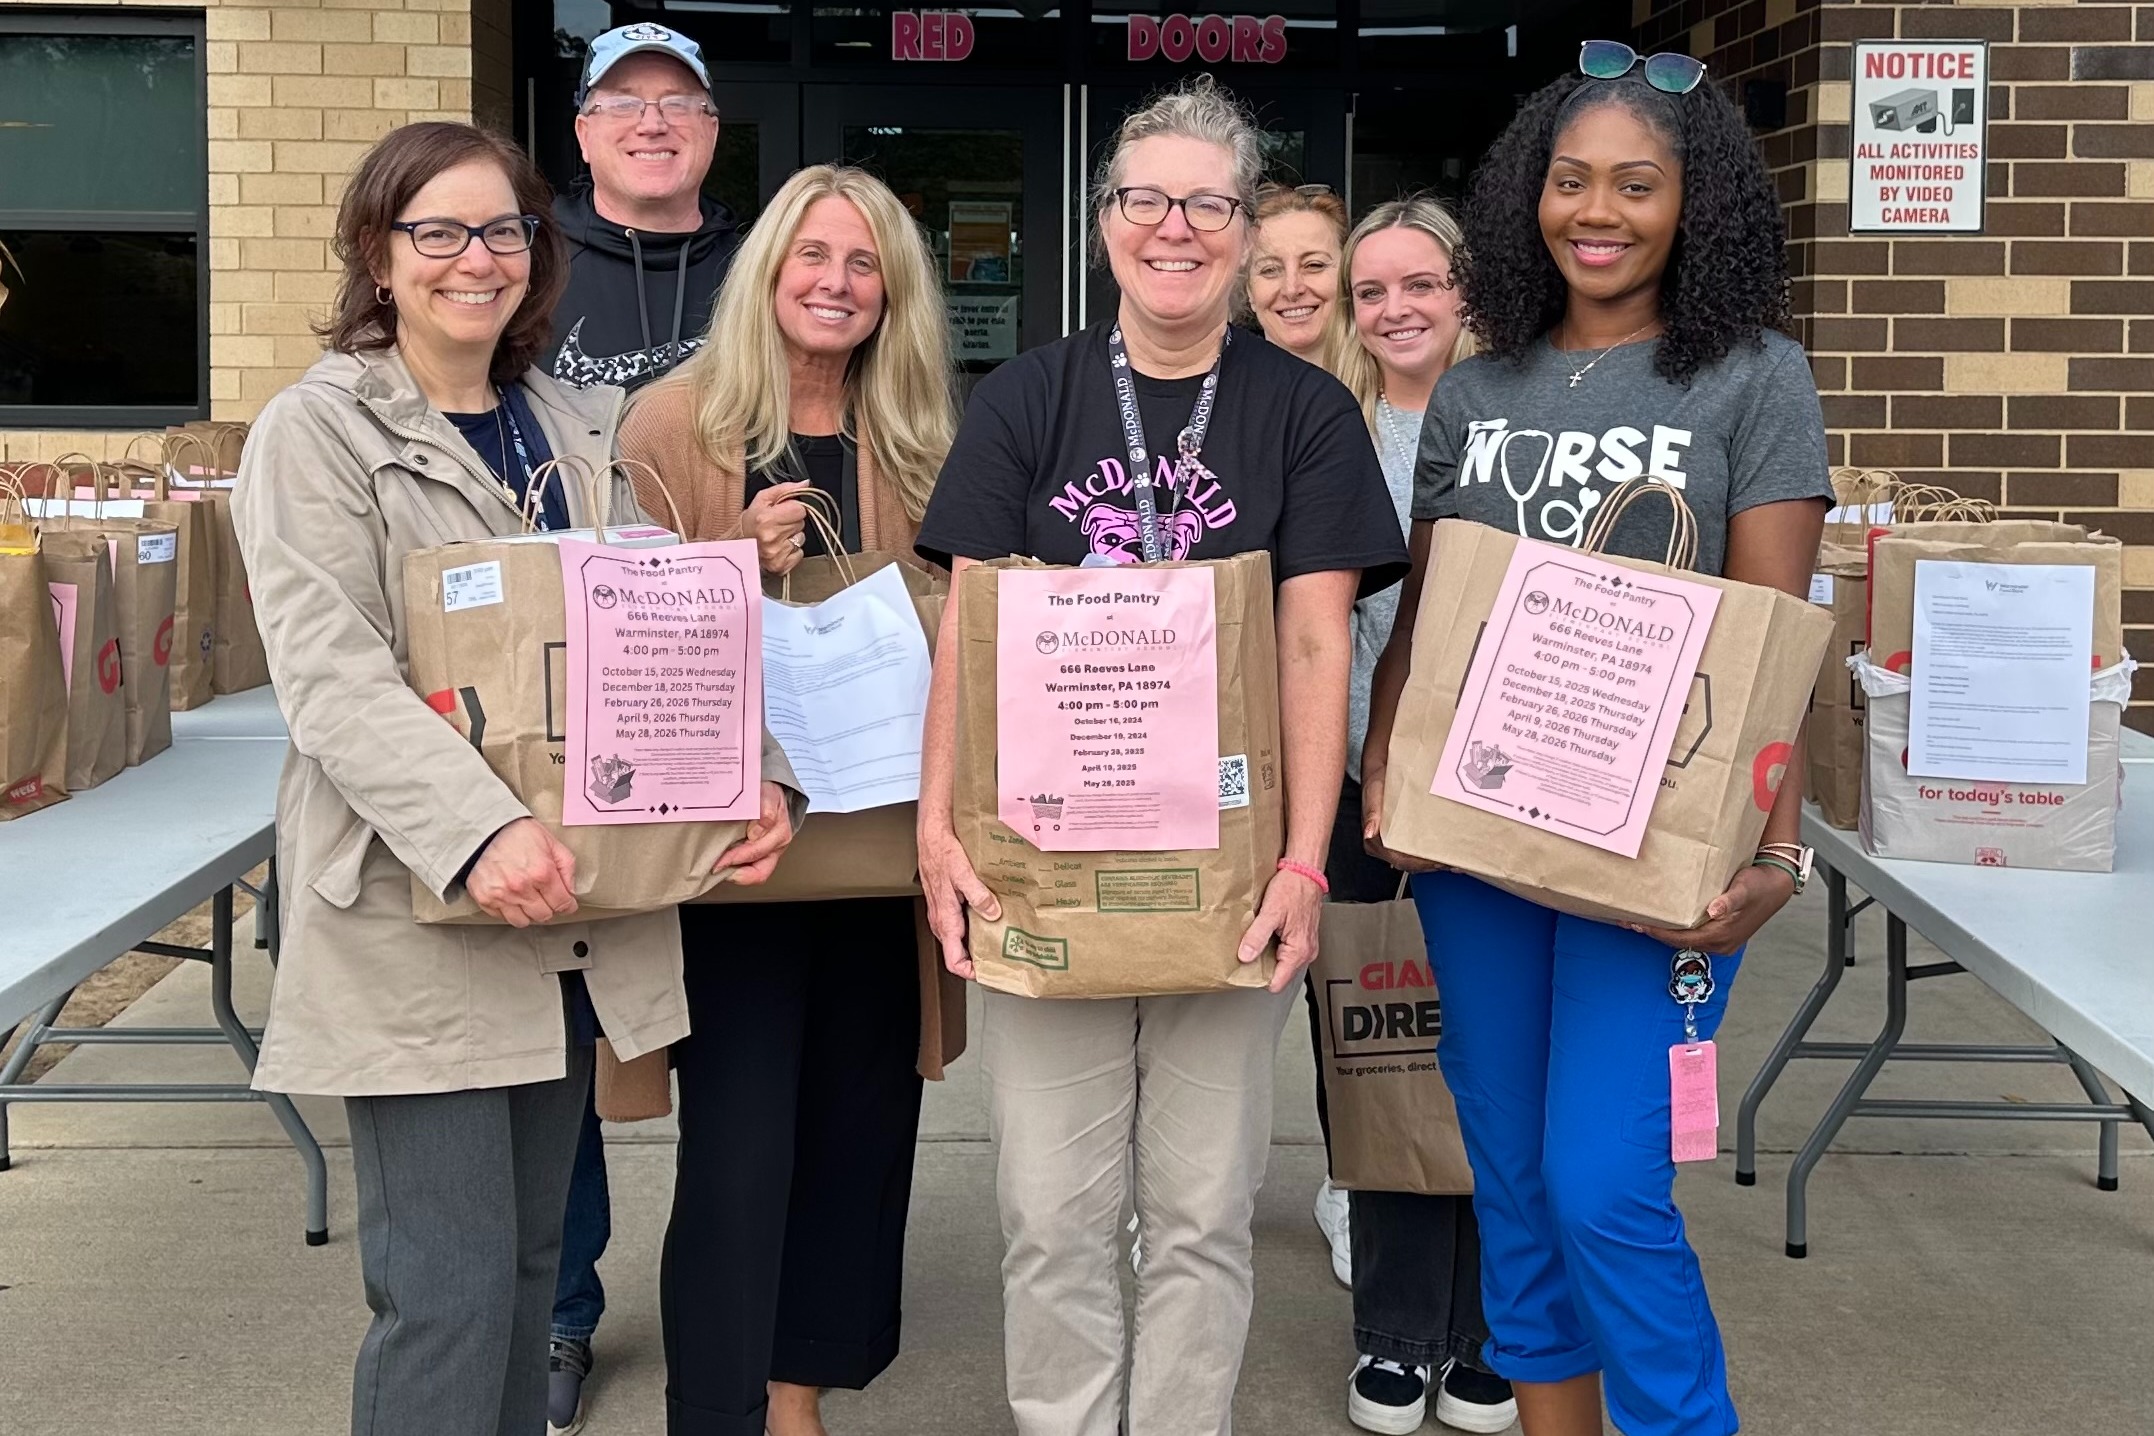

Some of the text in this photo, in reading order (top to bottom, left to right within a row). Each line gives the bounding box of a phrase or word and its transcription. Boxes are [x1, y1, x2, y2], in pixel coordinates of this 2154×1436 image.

[892, 11, 1287, 63] RED DOORS
[1866, 52, 1974, 79] NOTICE
[1857, 144, 1978, 159] ALL ACTIVITIES
[1870, 165, 1963, 180] MONITORED
[1880, 187, 1953, 202] BY VIDEO
[1882, 208, 1950, 223] CAMERA
[1117, 377, 1138, 446] McDONALD
[1195, 388, 1213, 435] McDON
[1460, 421, 1692, 500] NURSE
[1049, 455, 1237, 529] McDNALD
[139, 550, 151, 560] 60
[621, 565, 703, 577] The Food Pantry
[446, 590, 458, 606] 57
[618, 588, 734, 605] McDONALD
[1048, 593, 1160, 606] The Food Pantry
[1574, 577, 1656, 608] The Food Pantry
[628, 612, 716, 622] 666 Reeves Lane
[1551, 598, 1674, 642] McDONALD
[615, 628, 729, 640] Warminster, PA 18974
[1062, 629, 1176, 646] McDONALD
[1550, 622, 1643, 656] 666 Reeves Lane
[623, 645, 649, 655] 4:00
[651, 647, 668, 657] pm
[678, 646, 701, 655] 5:00
[704, 647, 719, 657] pm
[1532, 633, 1652, 674] Warminster, PA 18974
[602, 667, 736, 678] October 15, 2025 Wednesday
[1060, 663, 1155, 673] 666 Reeves Lane
[1534, 650, 1560, 664] 4:00
[1561, 660, 1579, 670] pm
[1589, 666, 1616, 680] 5:00
[1617, 676, 1636, 687] pm
[602, 683, 735, 693] December 18, 2025 Thursday
[1045, 681, 1170, 692] Warminster, PA 18974
[1507, 664, 1650, 713] October 15, 2025 Wednesday
[604, 698, 648, 709] February
[666, 698, 690, 707] 2026
[692, 698, 732, 708] Thursday
[1058, 701, 1083, 710] 4:00
[1086, 701, 1103, 711] pm
[1113, 700, 1137, 709] 5:00
[1140, 701, 1158, 710] pm
[1502, 678, 1645, 726] December 18, 2025 Thursday
[617, 713, 720, 724] April 9, 2026 Thursday
[1500, 692, 1637, 740] February 26, 2026 Thursday
[1852, 718, 1864, 727] Yo
[616, 729, 720, 740] May 28, 2026 Thursday
[1508, 709, 1620, 750] April 9, 2026 Thursday
[1502, 722, 1616, 764] May 28, 2026 Thursday
[549, 753, 565, 764] Yo
[1073, 749, 1109, 757] February
[1084, 780, 1100, 788] May
[1919, 786, 1943, 799] for
[2019, 792, 2064, 805] table
[1055, 880, 1076, 888] Glass
[1056, 898, 1081, 907] Heavy
[1343, 1001, 1441, 1041] DIRE
[1336, 1062, 1437, 1076] Your groceries, direct
